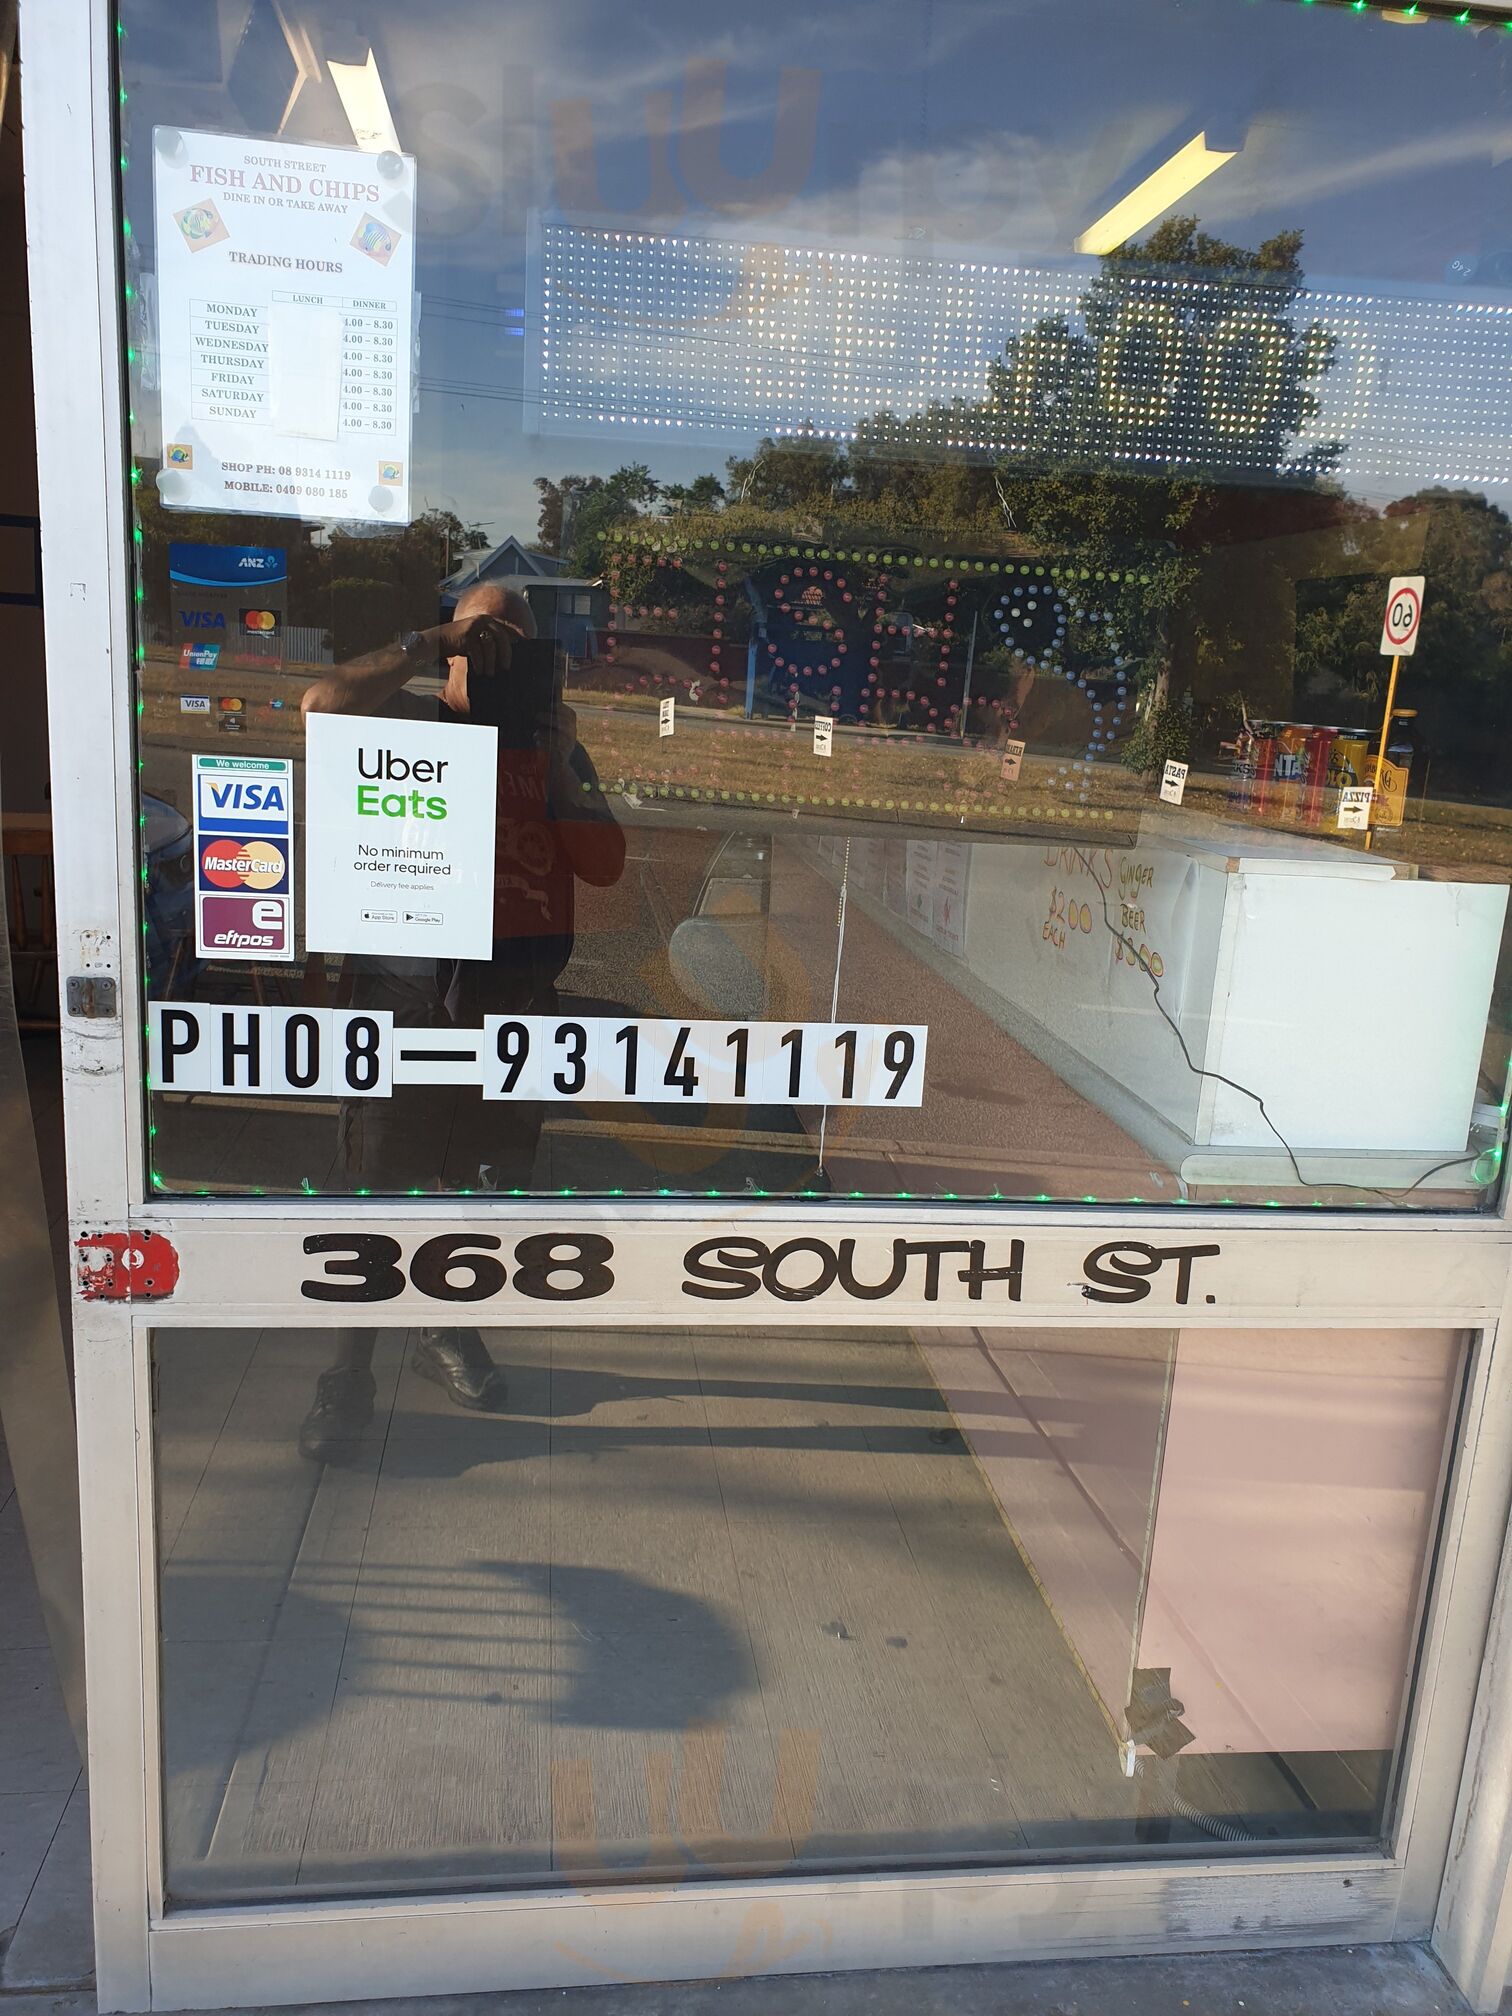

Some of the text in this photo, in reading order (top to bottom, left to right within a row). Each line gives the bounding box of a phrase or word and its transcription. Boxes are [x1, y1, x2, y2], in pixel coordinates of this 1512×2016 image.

[244, 155, 326, 173] SOUTH STREET
[190, 164, 380, 202] FISH AND CHIPS
[223, 192, 348, 214] DINE IN OR TAKE AWAY
[229, 251, 343, 273] TRADING HOURS
[292, 294, 387, 310] LUNCH DINNER
[206, 303, 258, 318] MONDAY
[205, 320, 260, 335] TUESDAY
[373, 320, 393, 330] 8.30
[195, 336, 269, 353] WEDNESDAY
[373, 336, 393, 346] 8.30
[200, 354, 264, 369] THURSDAY
[373, 353, 393, 363] 8.30
[211, 372, 255, 385] FRIDAY
[373, 370, 393, 380] 8.30
[201, 388, 264, 402] SATURDAY
[372, 387, 393, 397] 8.30
[209, 405, 257, 419] SUNDAY
[372, 403, 392, 413] 8.30
[372, 420, 392, 430] 8.30
[221, 461, 351, 480] SHOP PH: 08 9314 1119
[224, 480, 273, 493] MOBILE:
[276, 483, 302, 495] 0409
[329, 487, 348, 499] 185
[238, 557, 265, 568] ANZ
[178, 610, 226, 629] VISA
[183, 649, 218, 660] UnionPay
[186, 700, 206, 708] VISA
[216, 759, 270, 770] We welcome
[358, 748, 449, 783] Uber
[206, 782, 285, 811] VISA
[357, 785, 448, 820] Eats
[358, 844, 444, 861] No minimum
[204, 856, 284, 874] MasterCard
[353, 860, 452, 876] order required
[370, 881, 397, 890] Delivery
[1120, 903, 1147, 936] BEER
[213, 929, 274, 947] eftpos
[1043, 921, 1066, 950] EACH
[300, 1232, 1221, 1304] 368 SOUTH ST.
